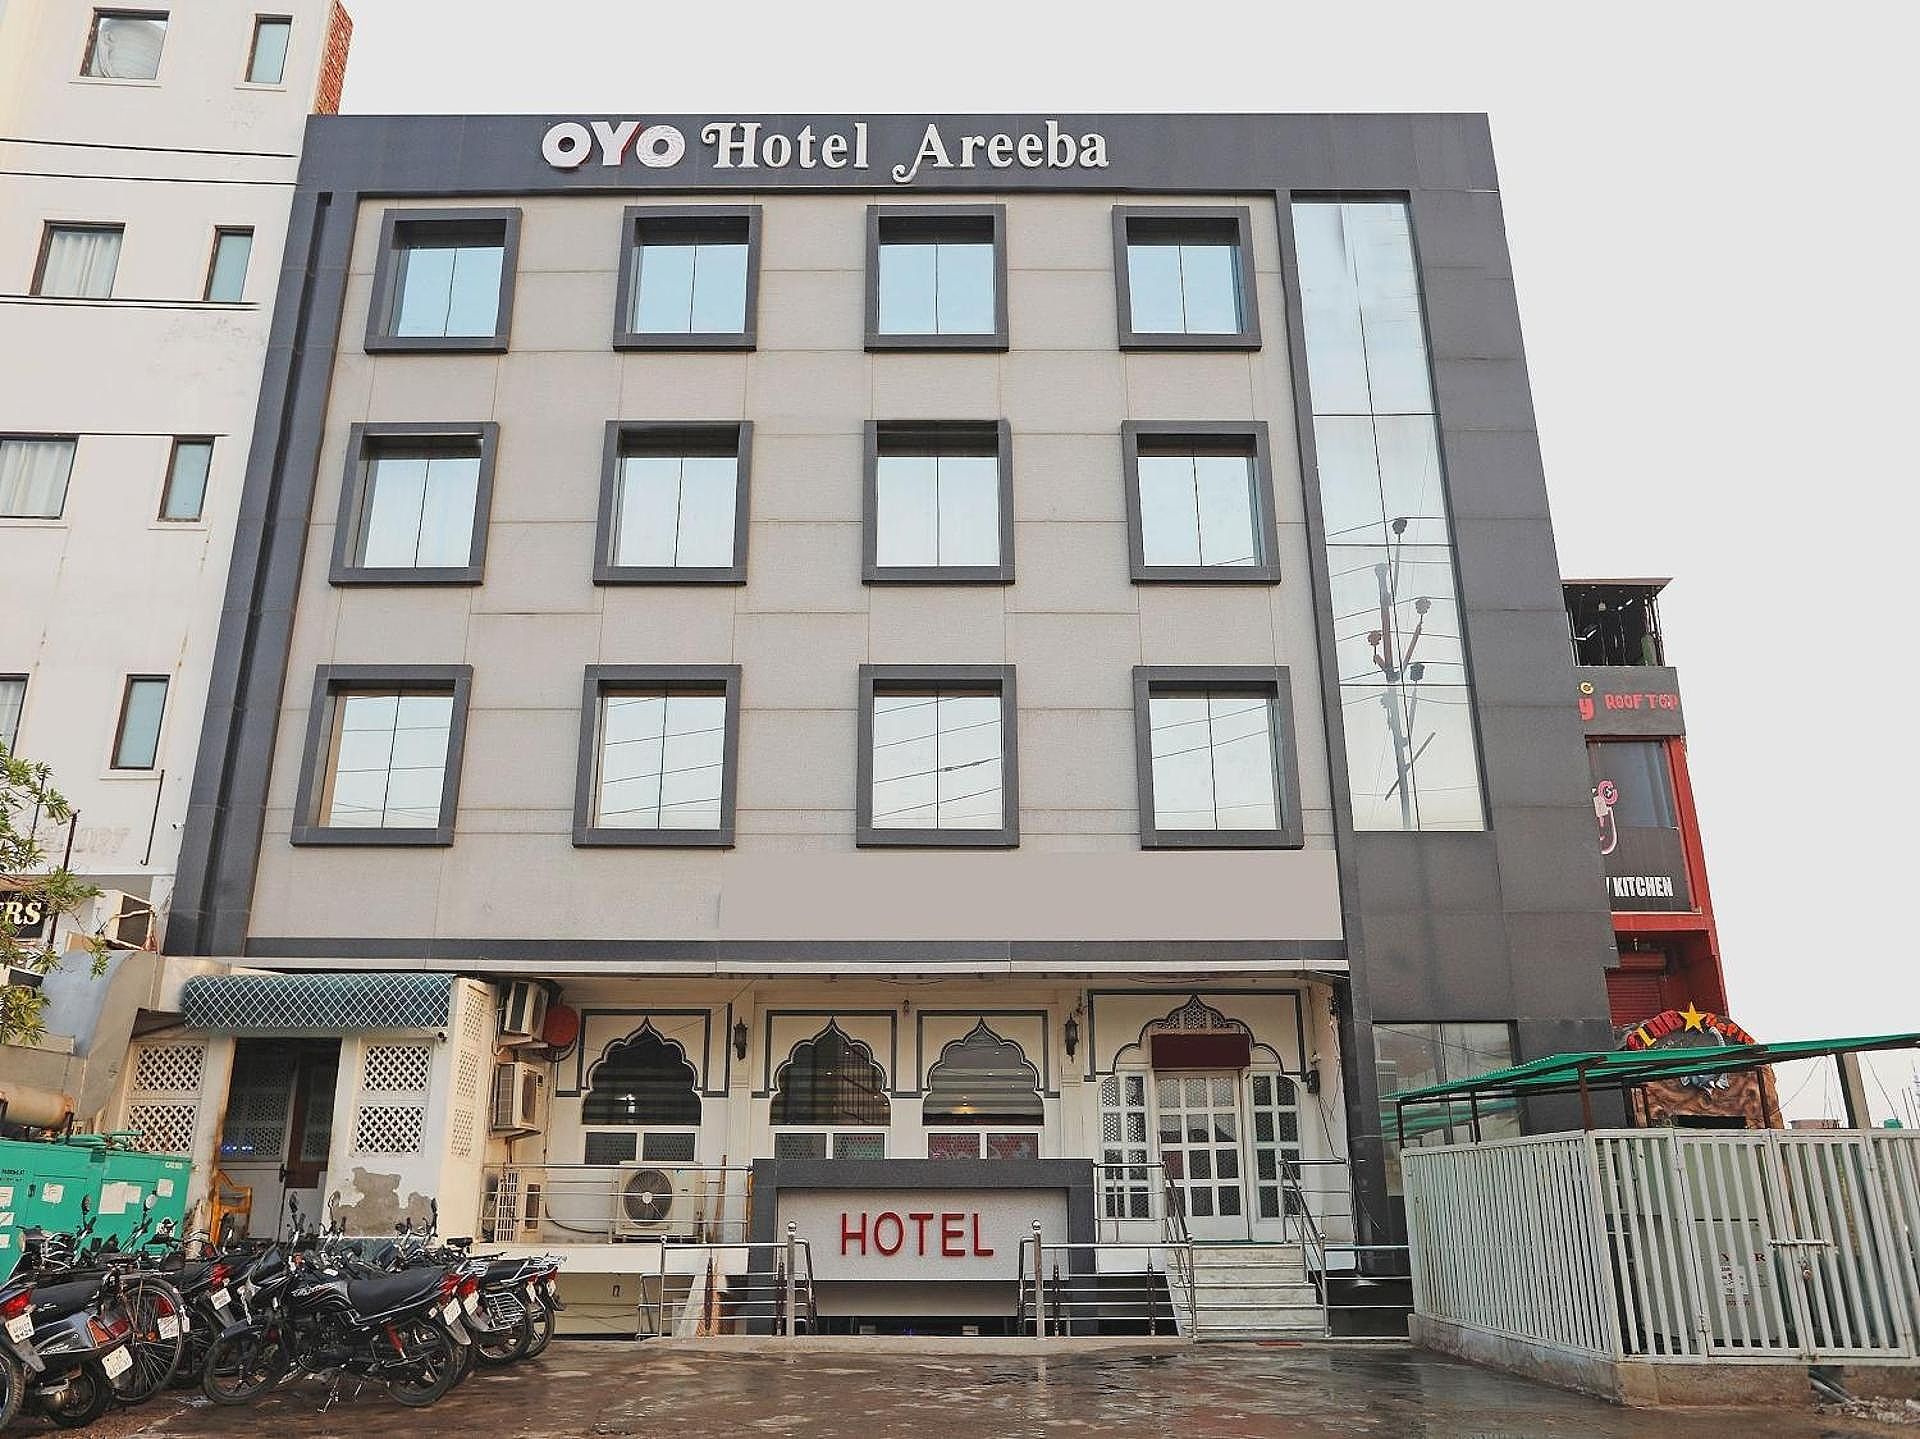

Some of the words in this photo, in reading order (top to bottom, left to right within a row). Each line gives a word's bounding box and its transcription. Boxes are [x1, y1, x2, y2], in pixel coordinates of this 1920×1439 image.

[541, 121, 686, 170] OYO
[701, 121, 870, 170] Hotel
[892, 120, 1110, 184] Areeba
[1612, 876, 1674, 898] KITCHEN
[840, 1211, 995, 1257] HOTEL
